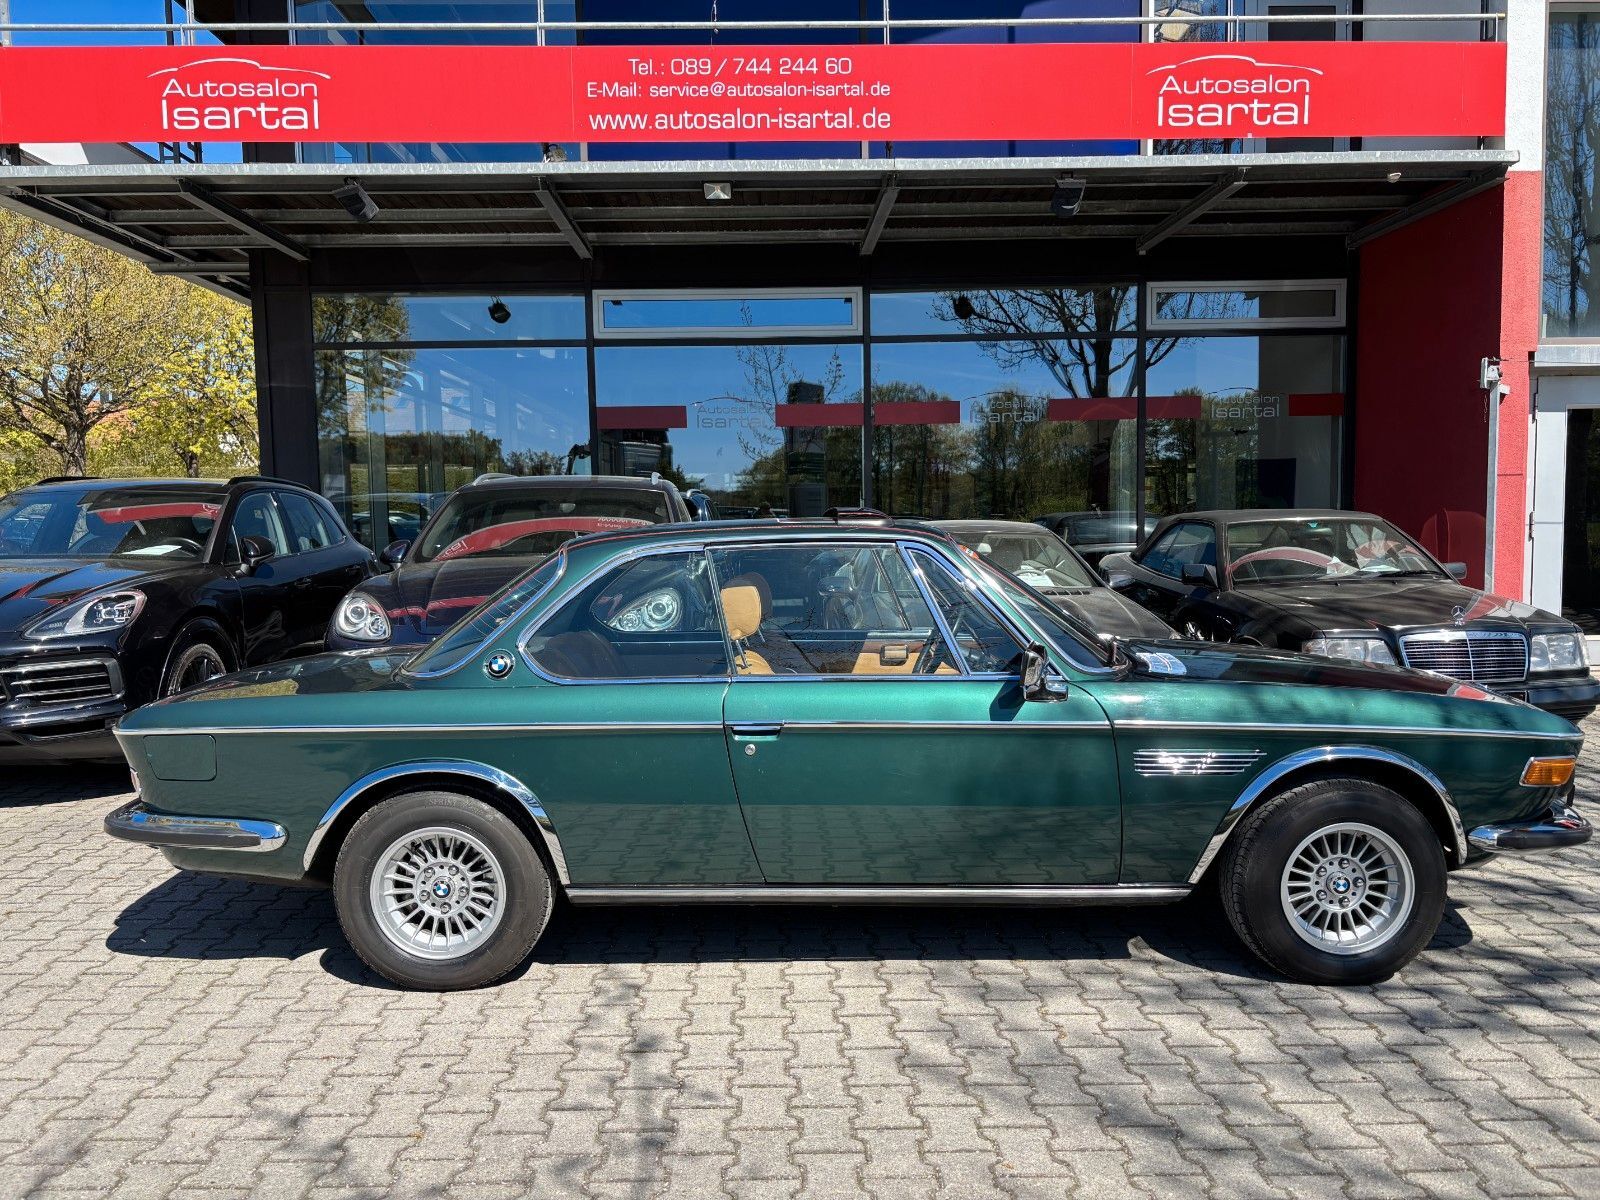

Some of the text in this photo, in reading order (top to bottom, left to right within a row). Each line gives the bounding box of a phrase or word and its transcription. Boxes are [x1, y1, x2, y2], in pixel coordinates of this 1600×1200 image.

[627, 58, 666, 76] Tel.:
[670, 58, 712, 76] 089
[732, 57, 772, 75] 744
[779, 57, 819, 75] 244
[825, 57, 852, 75] 60
[161, 78, 318, 98] Autosalon
[587, 80, 891, 98] E-Mail: service@autosalon-isartal.de
[1160, 74, 1310, 95] Autosalon
[161, 98, 320, 130] Isartal
[588, 106, 891, 130] www.autosalon-isartal.de
[1157, 94, 1310, 127] Isartal
[697, 404, 768, 414] Autosal
[970, 399, 1040, 409] Atosalo
[1211, 404, 1280, 418] Isartal
